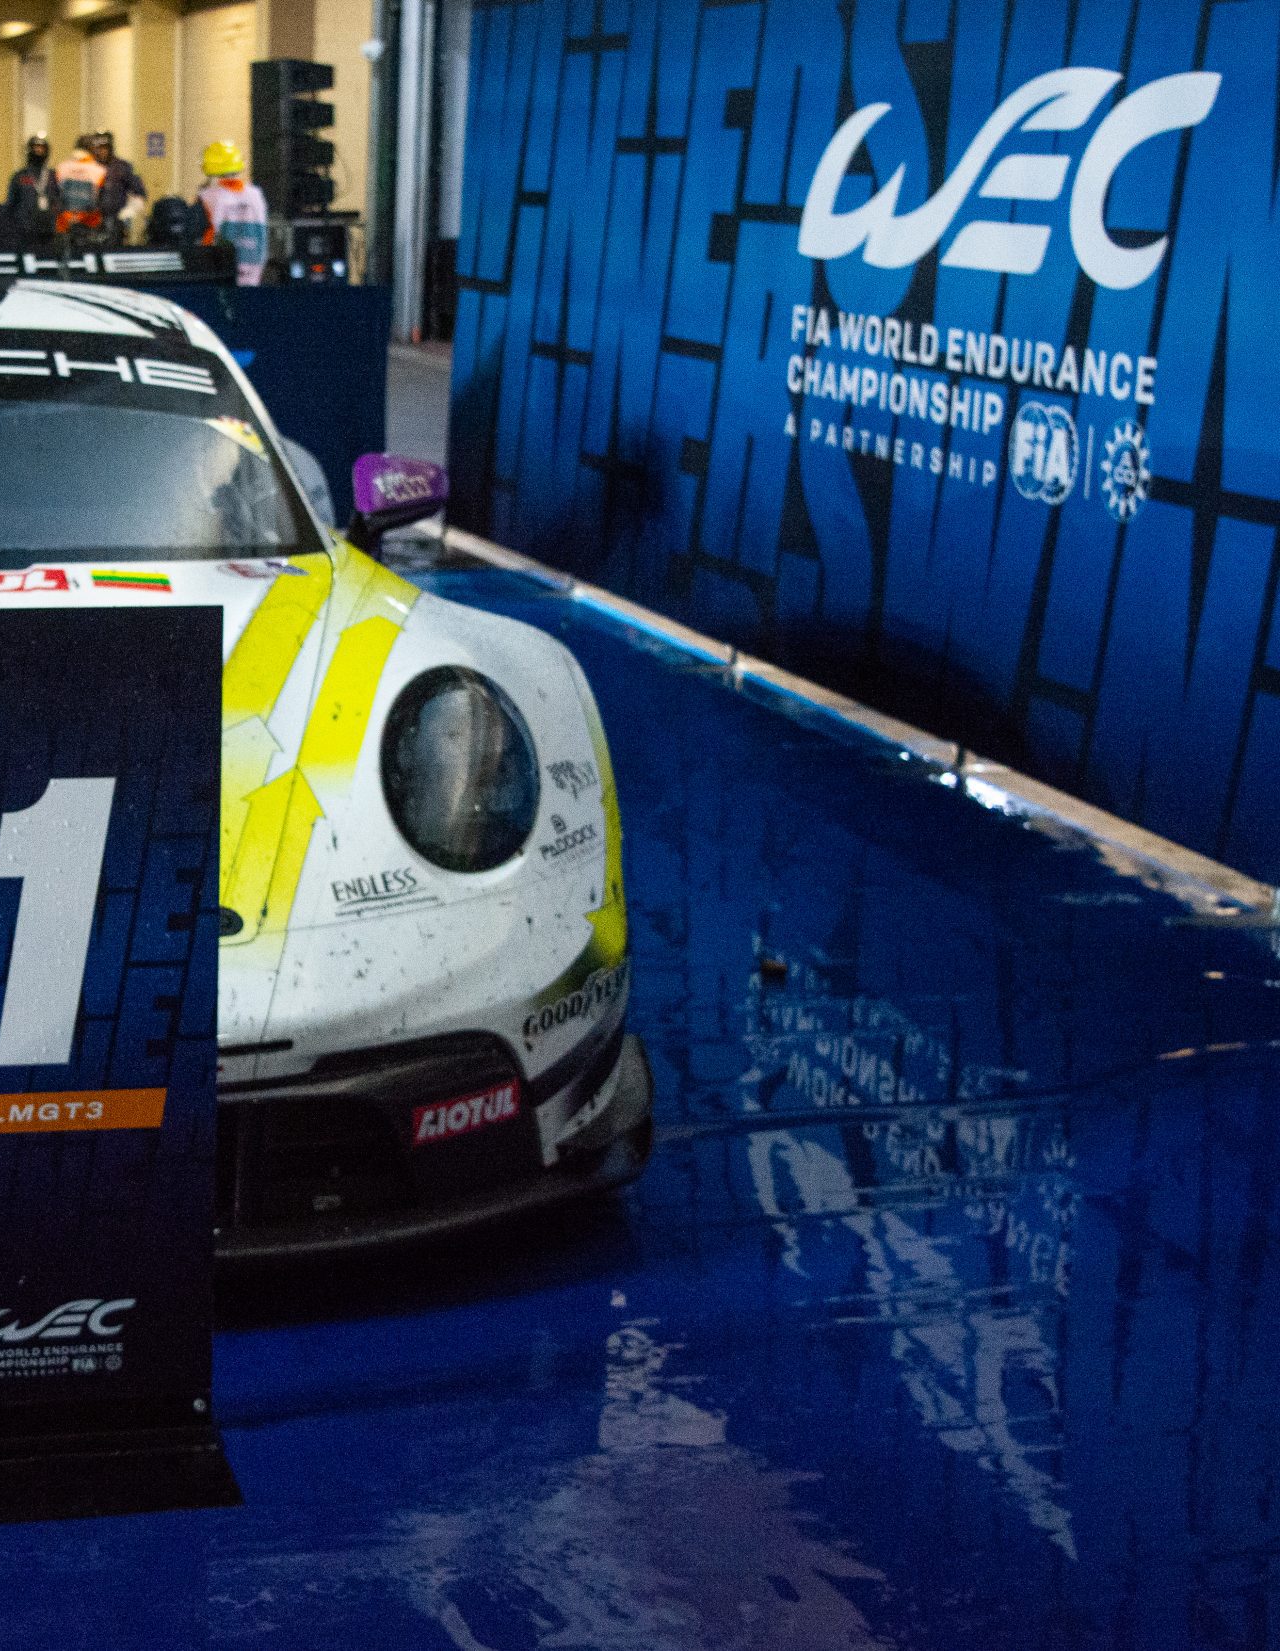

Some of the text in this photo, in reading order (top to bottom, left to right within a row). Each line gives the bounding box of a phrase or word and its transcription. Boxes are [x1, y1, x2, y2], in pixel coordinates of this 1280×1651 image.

[797, 66, 1222, 290] WEC
[790, 303, 1158, 405] FIA WORLD ENDURANCE
[786, 353, 1004, 435] CHAMPIONSHIP
[784, 412, 997, 487] A PARTNERSHIP
[331, 867, 417, 901] ENDLESS
[44, 1343, 124, 1356] ENDURANCE
